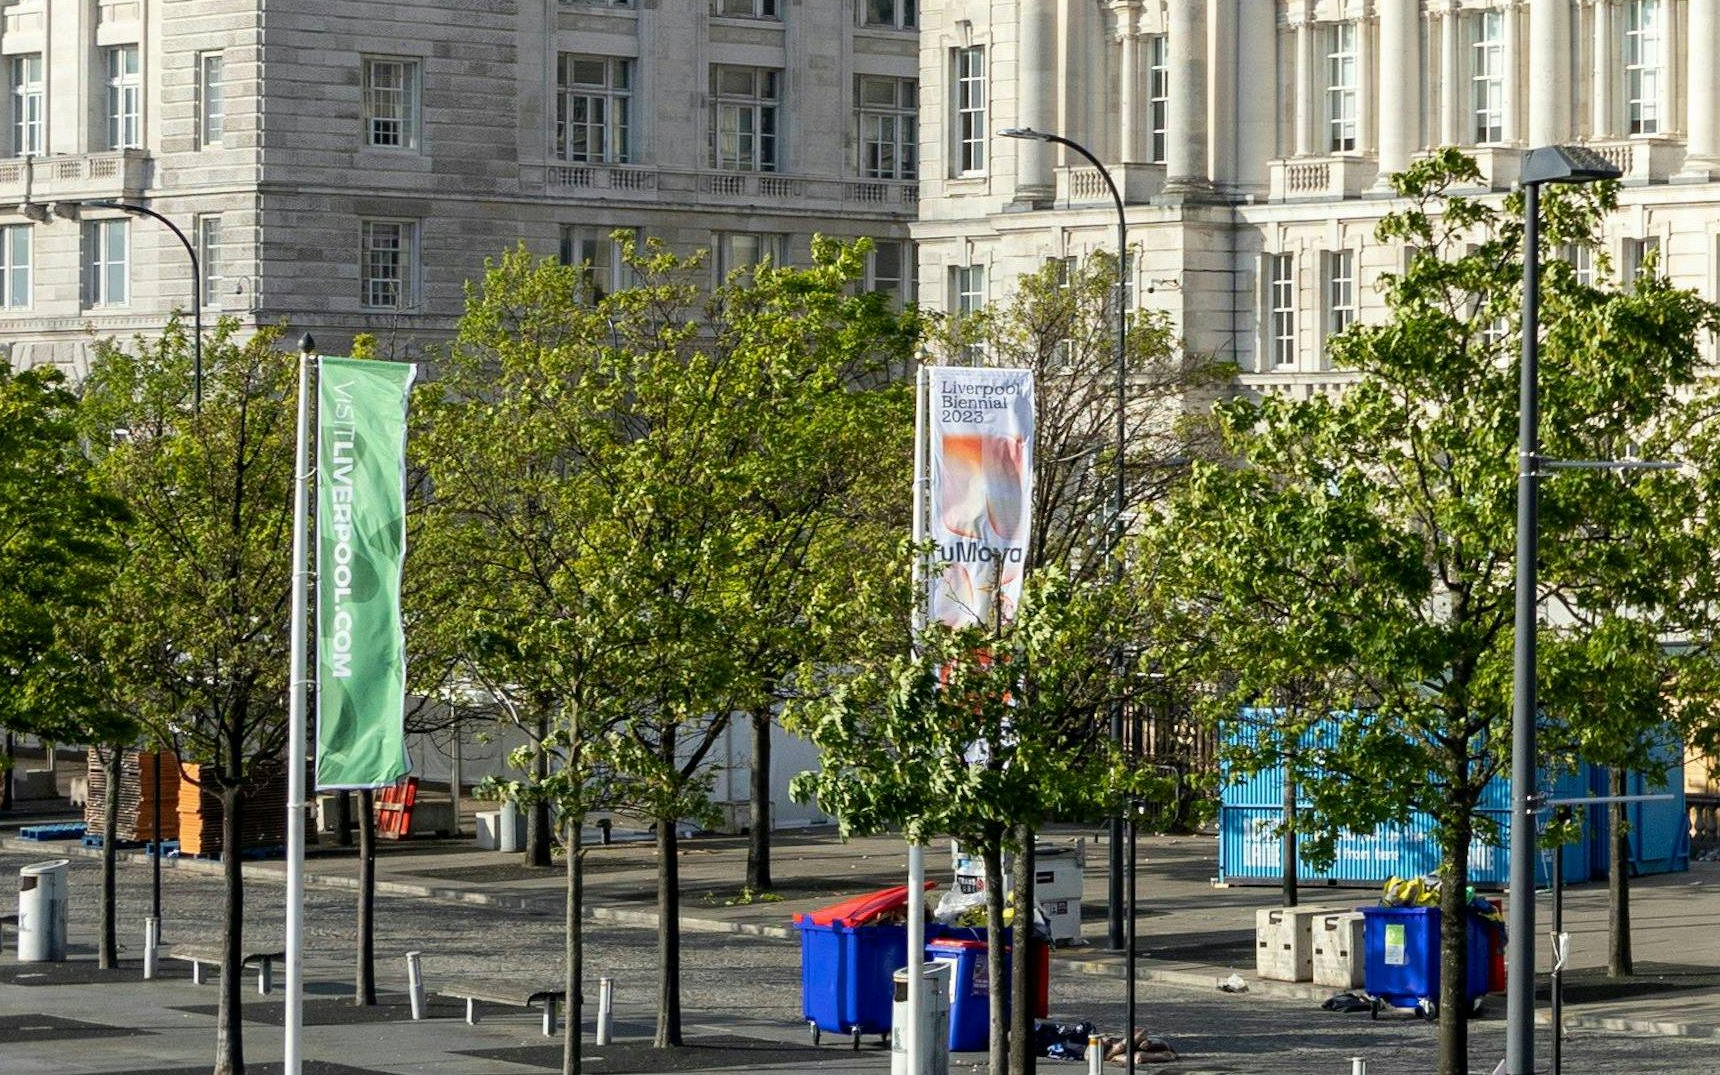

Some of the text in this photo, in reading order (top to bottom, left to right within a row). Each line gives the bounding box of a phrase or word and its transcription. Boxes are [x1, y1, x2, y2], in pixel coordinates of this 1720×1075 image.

[942, 381, 1020, 398] Liverpool
[942, 396, 1007, 409] Biennial
[942, 410, 984, 423] 2023
[332, 380, 355, 678] VISITLIVERPOOL.COM
